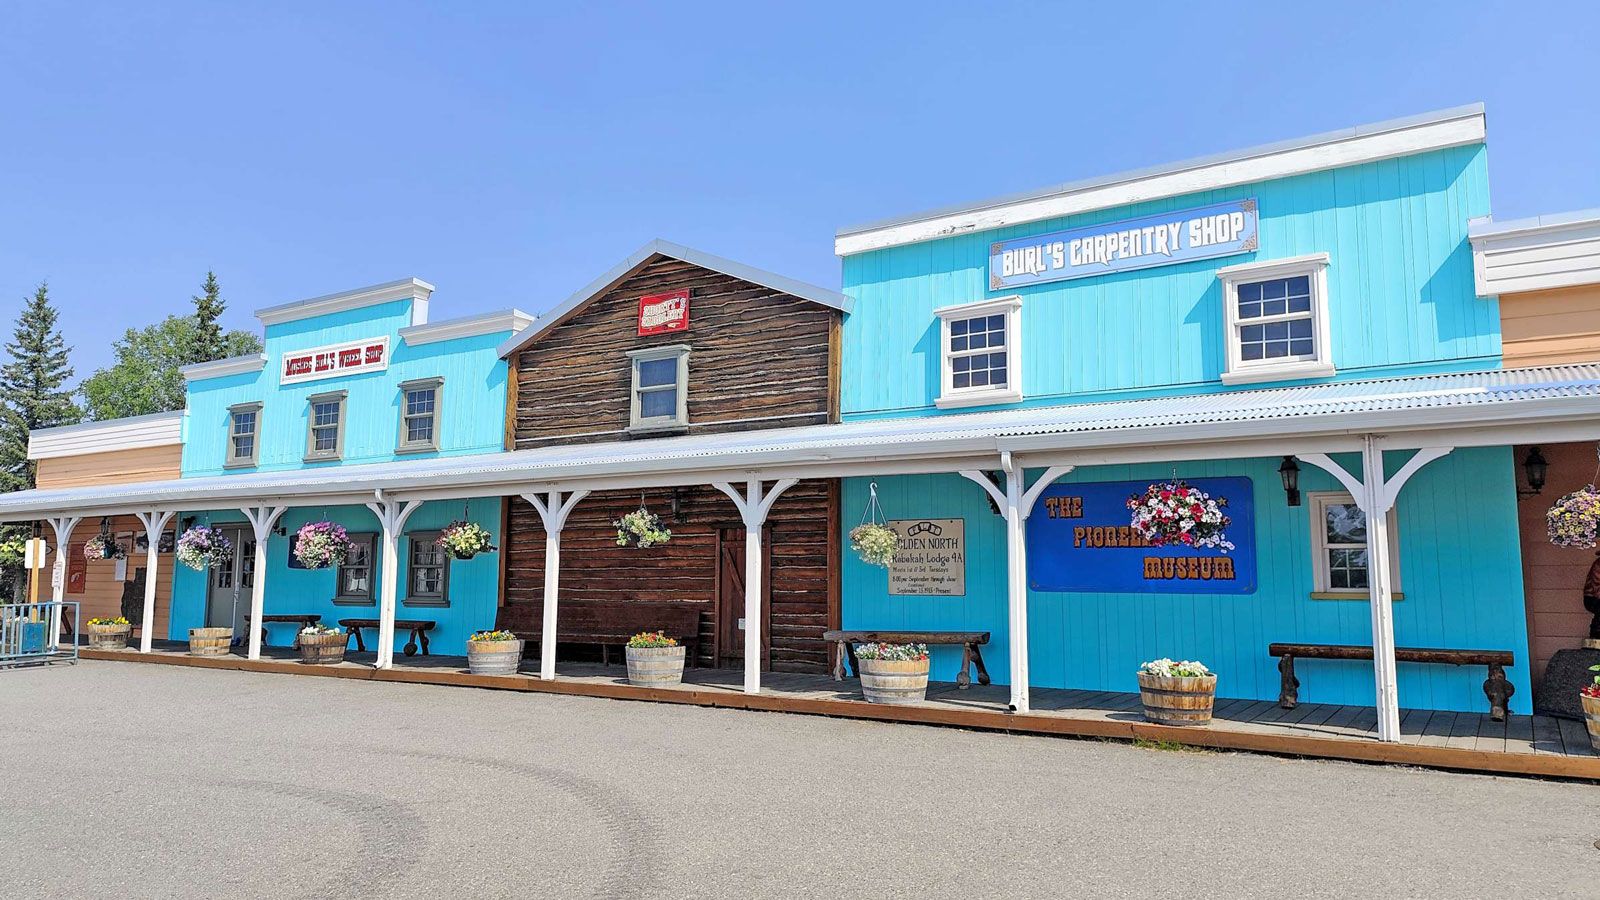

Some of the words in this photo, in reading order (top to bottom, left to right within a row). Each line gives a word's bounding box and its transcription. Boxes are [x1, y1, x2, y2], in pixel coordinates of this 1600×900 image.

[1002, 241, 1066, 277] BURL'S
[1070, 221, 1183, 267] CARPENTRY
[1189, 212, 1244, 248] SHOP
[315, 352, 335, 372] BILL'S
[339, 348, 361, 368] WHEEL
[365, 344, 384, 364] SHOP
[1045, 496, 1084, 519] THE
[892, 538, 926, 550] OLDEN
[928, 538, 958, 549] NORTH
[1073, 526, 1156, 548] PIONEE
[927, 553, 950, 567] Lodge
[929, 566, 949, 574] Tuesdays
[1143, 556, 1237, 581] MUSEUM
